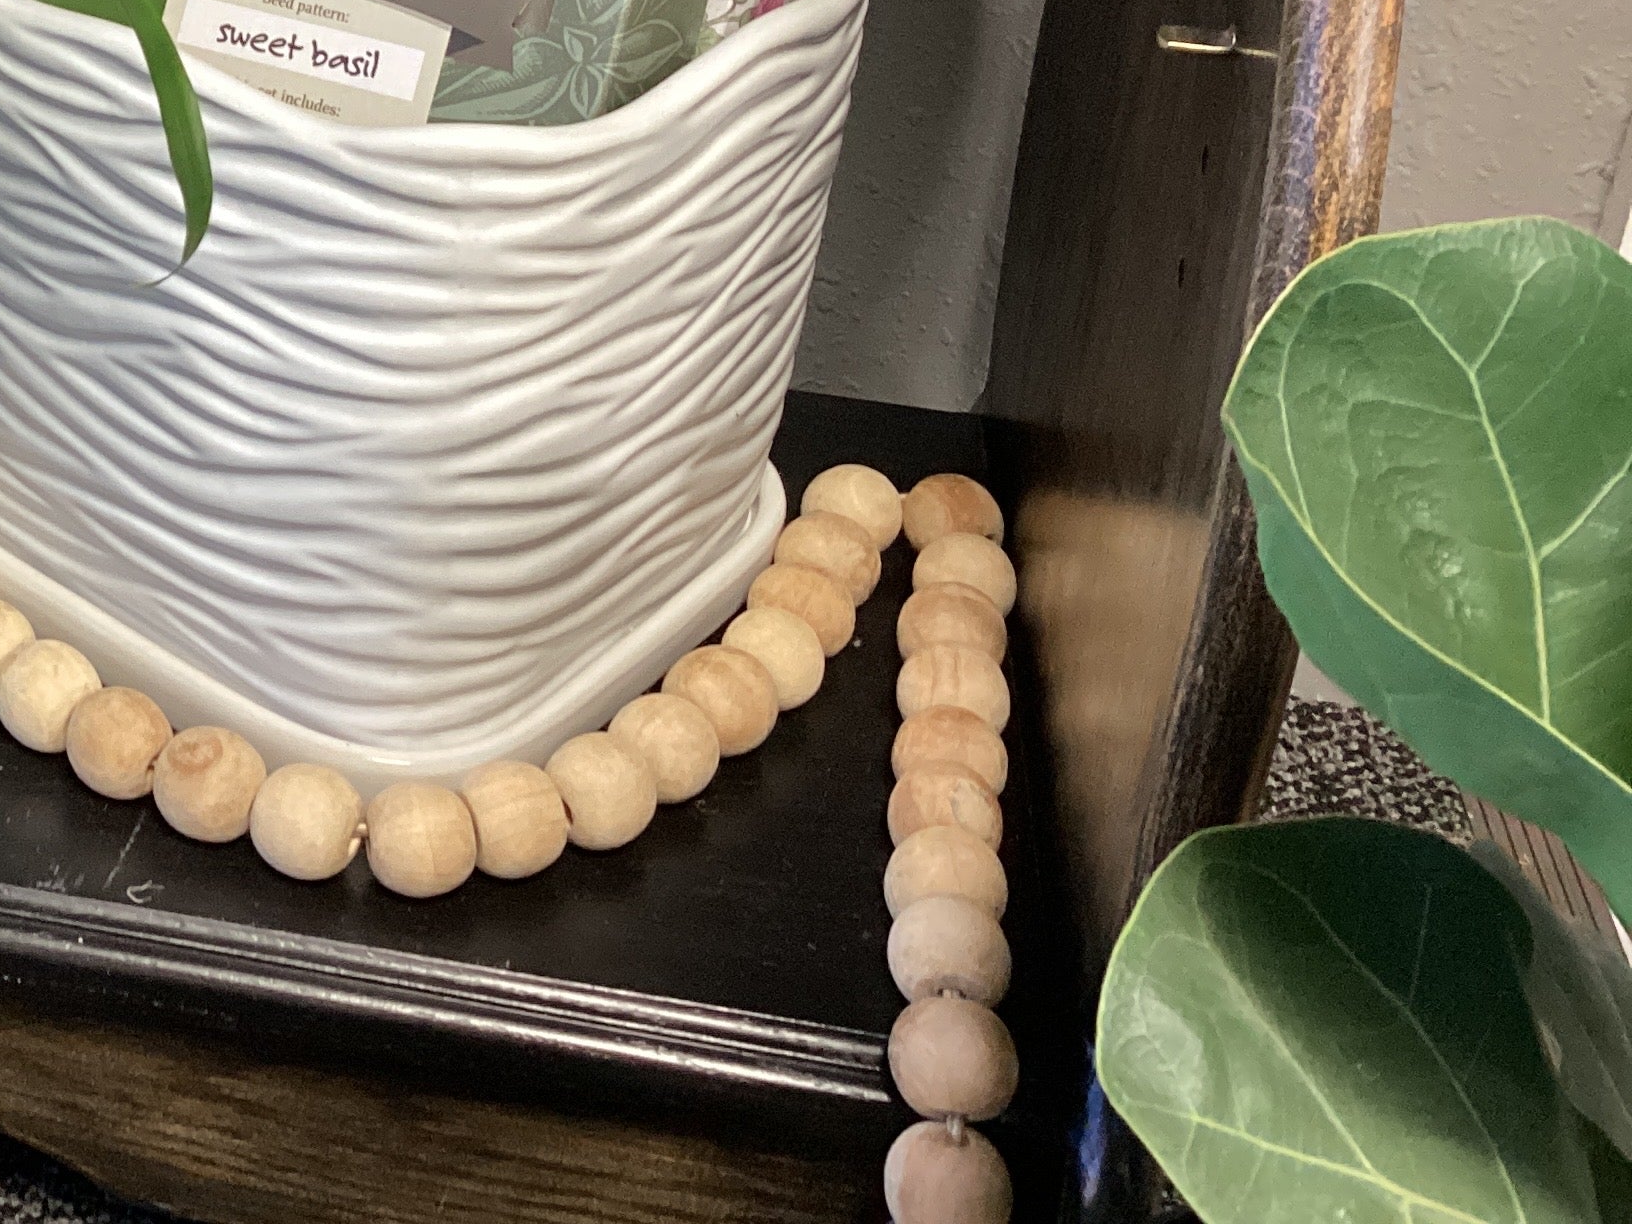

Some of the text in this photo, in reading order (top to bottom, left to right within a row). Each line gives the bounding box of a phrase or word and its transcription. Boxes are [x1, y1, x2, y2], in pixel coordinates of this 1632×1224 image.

[297, 0, 351, 25] pattern:
[216, 21, 381, 79] sweet basil
[280, 89, 342, 118] includes:
